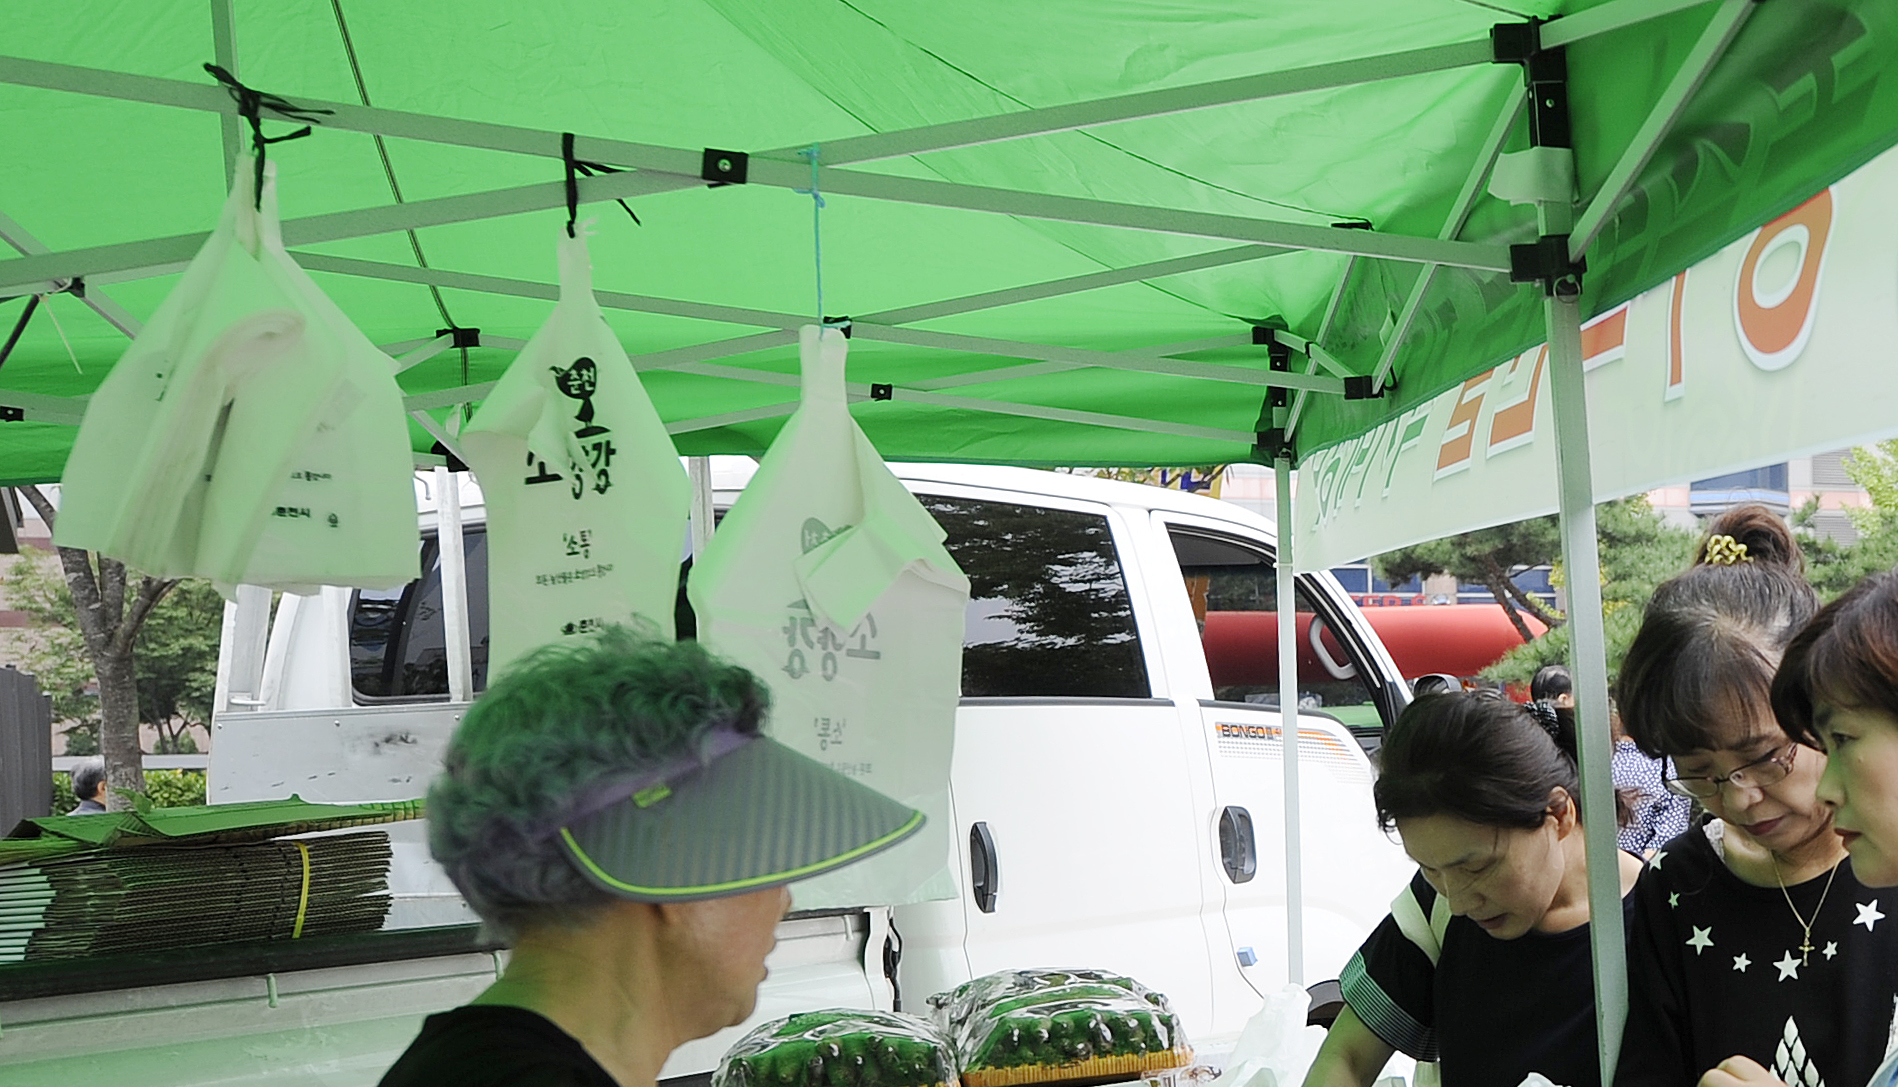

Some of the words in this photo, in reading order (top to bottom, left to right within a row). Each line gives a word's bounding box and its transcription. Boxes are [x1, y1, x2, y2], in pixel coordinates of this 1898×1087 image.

[567, 366, 595, 395] 춘천
[524, 439, 617, 500] 소강
[1221, 724, 1266, 739] BONGO
